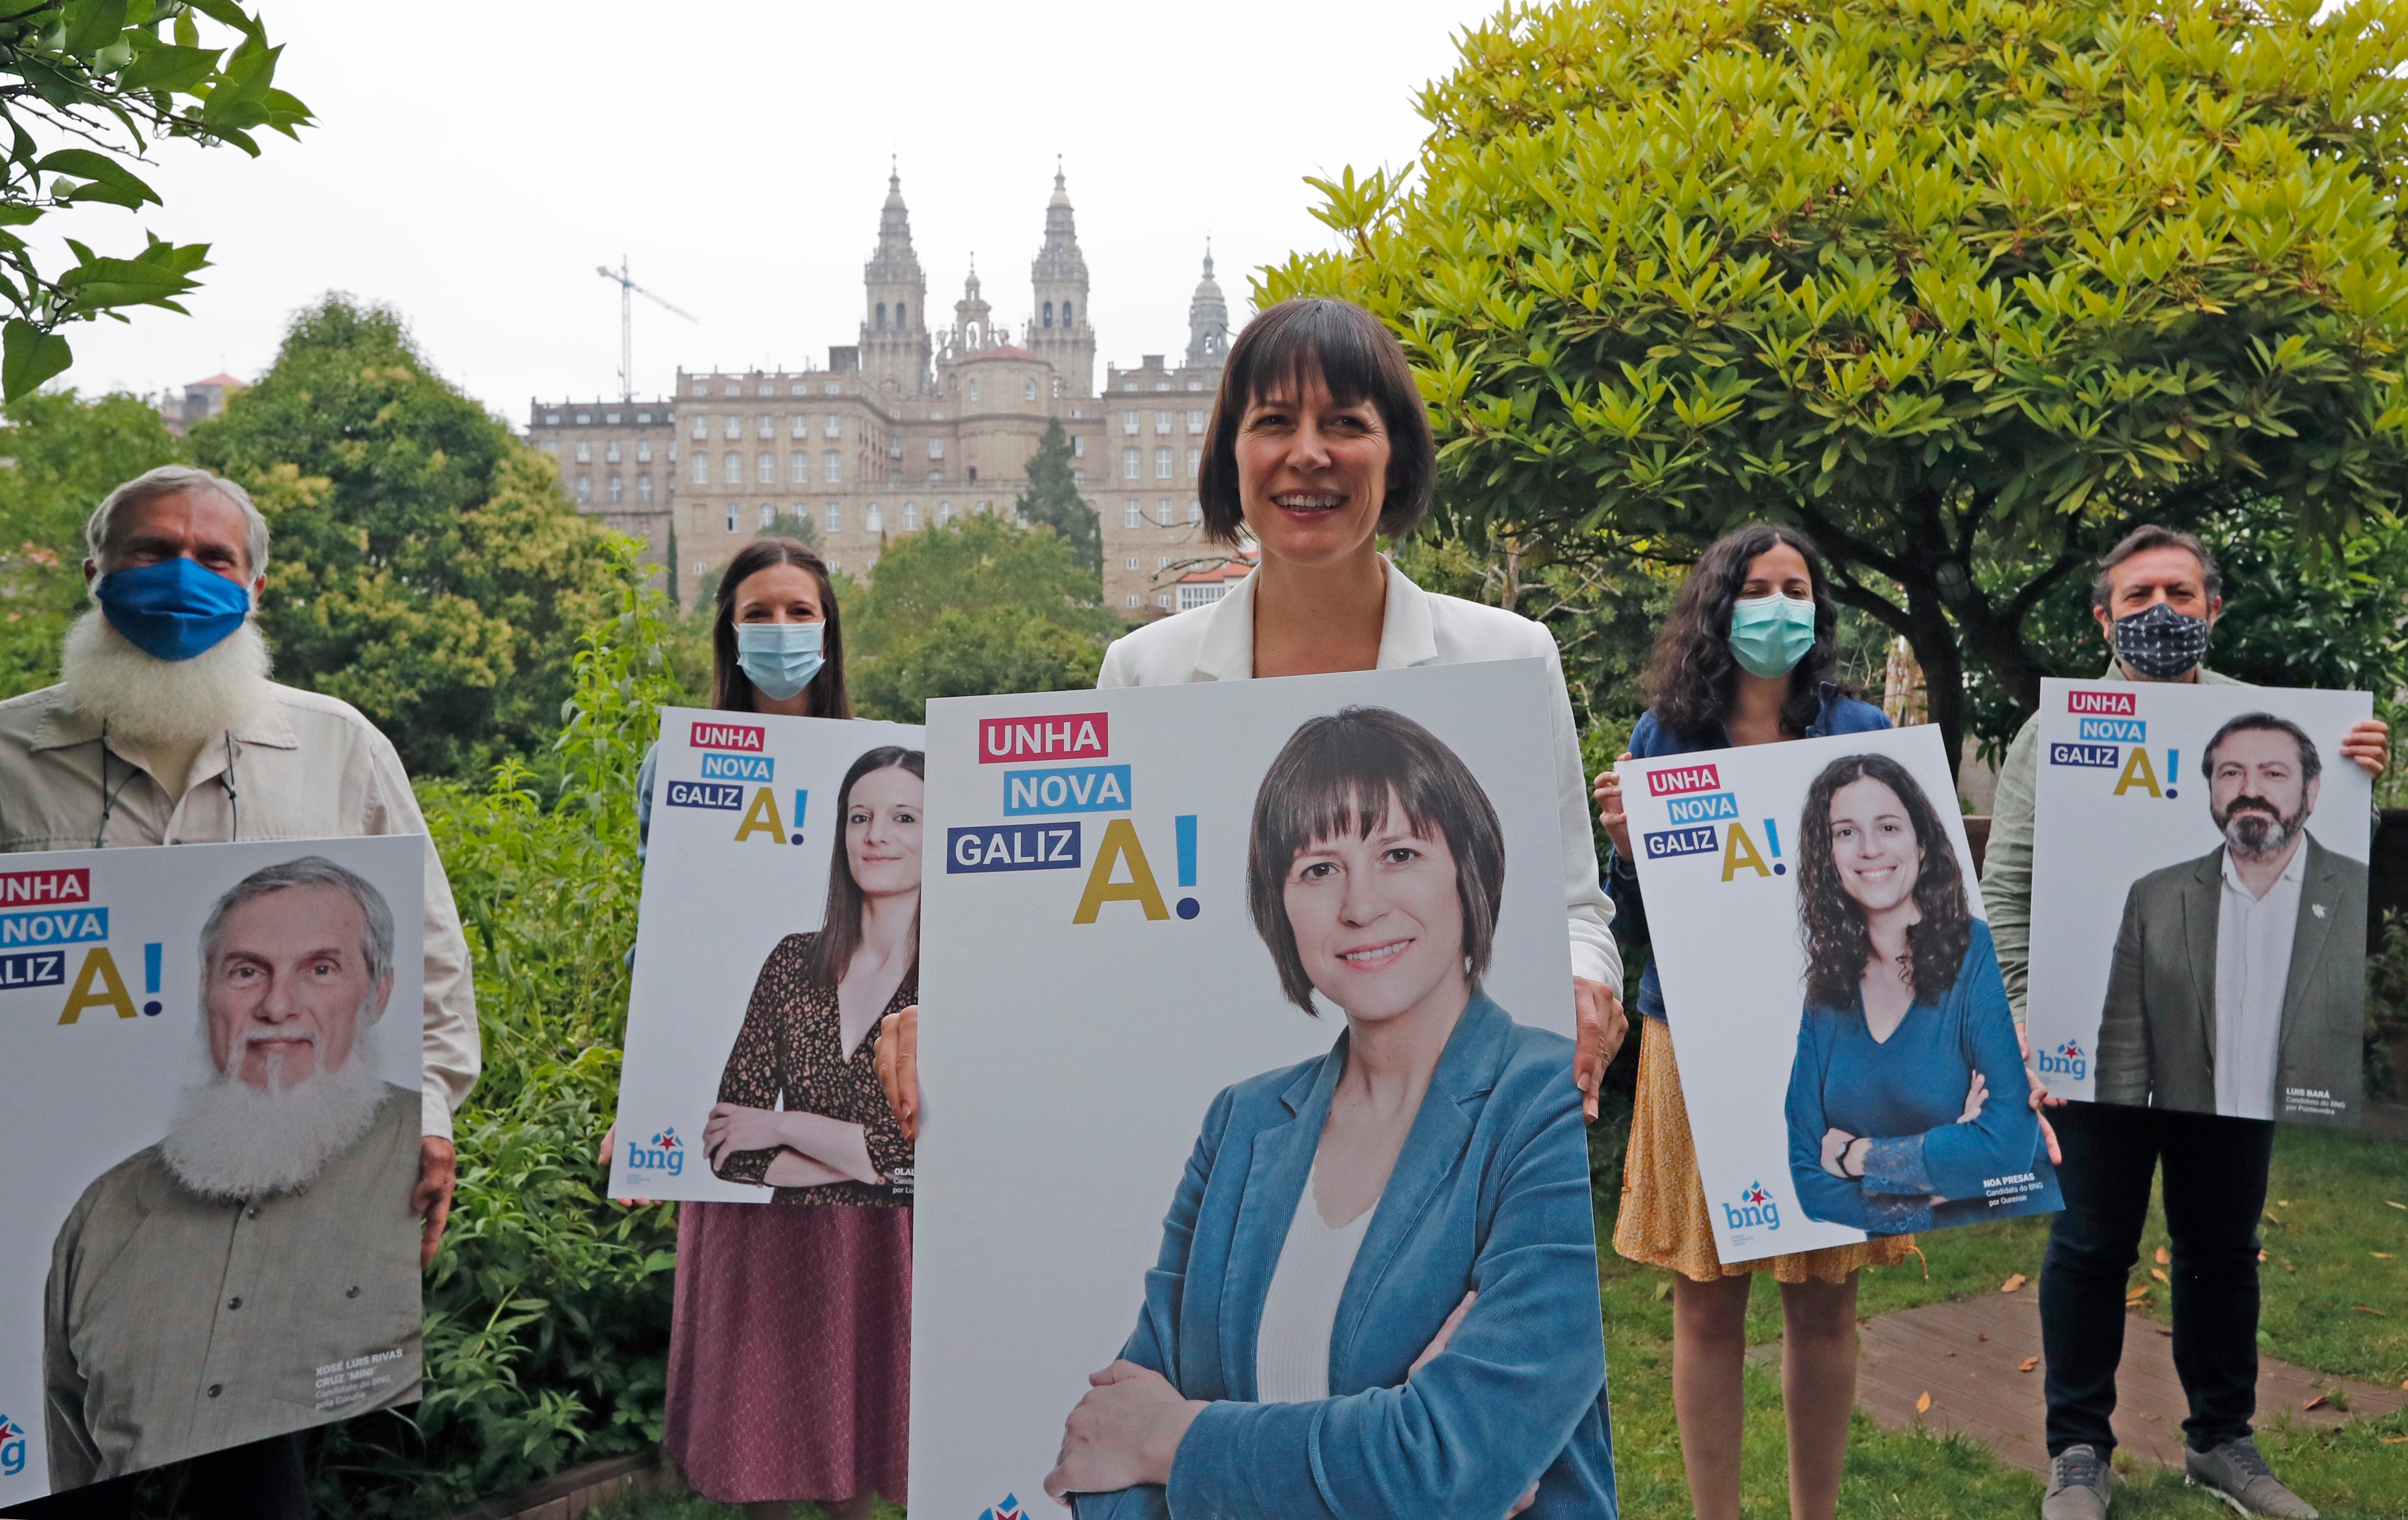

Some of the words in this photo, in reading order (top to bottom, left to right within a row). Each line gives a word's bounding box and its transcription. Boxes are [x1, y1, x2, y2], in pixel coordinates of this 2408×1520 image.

[2072, 694, 2131, 712] UNHA
[695, 726, 759, 748] UNHA
[987, 720, 1102, 756] UNHA
[2083, 721, 2142, 740] NOVA
[706, 757, 770, 778] NOVA
[1651, 768, 1716, 792] UNHA
[1011, 773, 1125, 809] NOVA
[1671, 797, 1734, 821] NOVA
[0, 874, 84, 901] NHA
[3, 913, 103, 943] NOVA
[2038, 1050, 2086, 1080] bng
[2286, 1087, 2305, 1096] LUIS
[628, 1142, 684, 1176] bng
[1983, 1178, 2002, 1188] NOA
[2002, 1173, 2035, 1185] PRESAS
[1986, 1187, 2019, 1197] Candidata
[2028, 1182, 2043, 1191] BNG
[1988, 1199, 1999, 1208] por
[2000, 1195, 2027, 1204] Ourense
[1722, 1203, 1780, 1231] bng
[346, 1356, 370, 1369] LUIS
[372, 1349, 403, 1363] RIVAS
[315, 1374, 344, 1388] CRUZ
[372, 1375, 390, 1386] BNG
